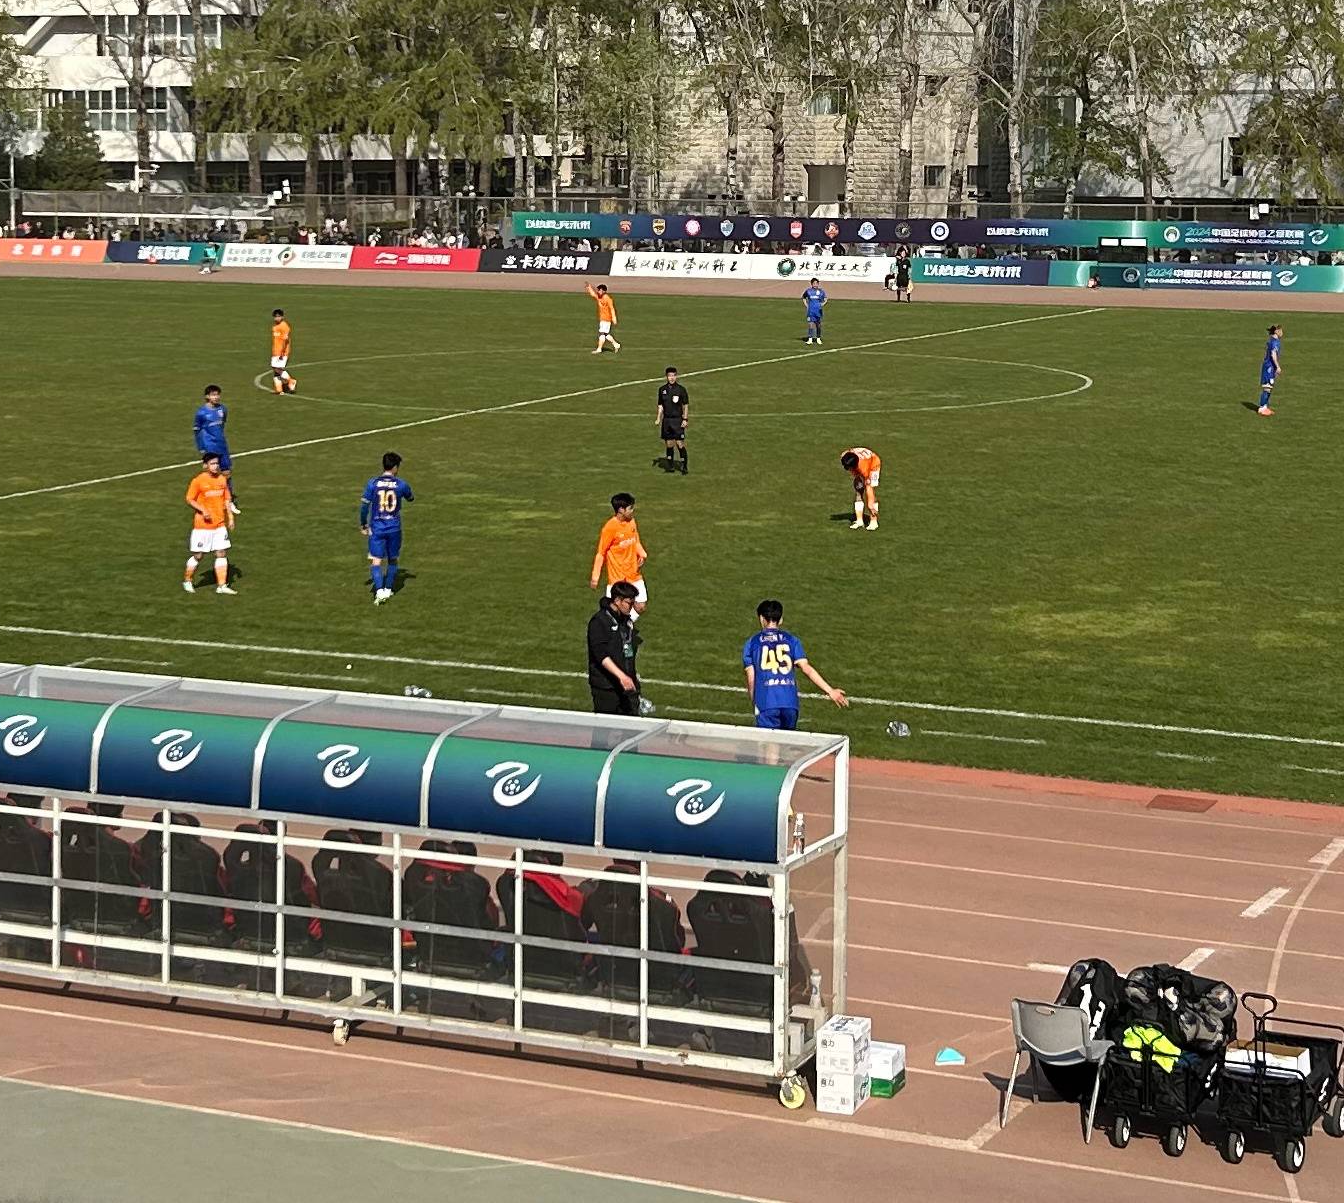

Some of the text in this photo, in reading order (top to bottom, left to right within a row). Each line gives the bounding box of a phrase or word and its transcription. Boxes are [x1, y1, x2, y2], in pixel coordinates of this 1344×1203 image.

[1185, 227, 1210, 236] 2024
[520, 254, 590, 271] 卡尔美体育
[1146, 268, 1173, 277] 2024
[378, 489, 397, 513] 10
[760, 643, 793, 675] 45
